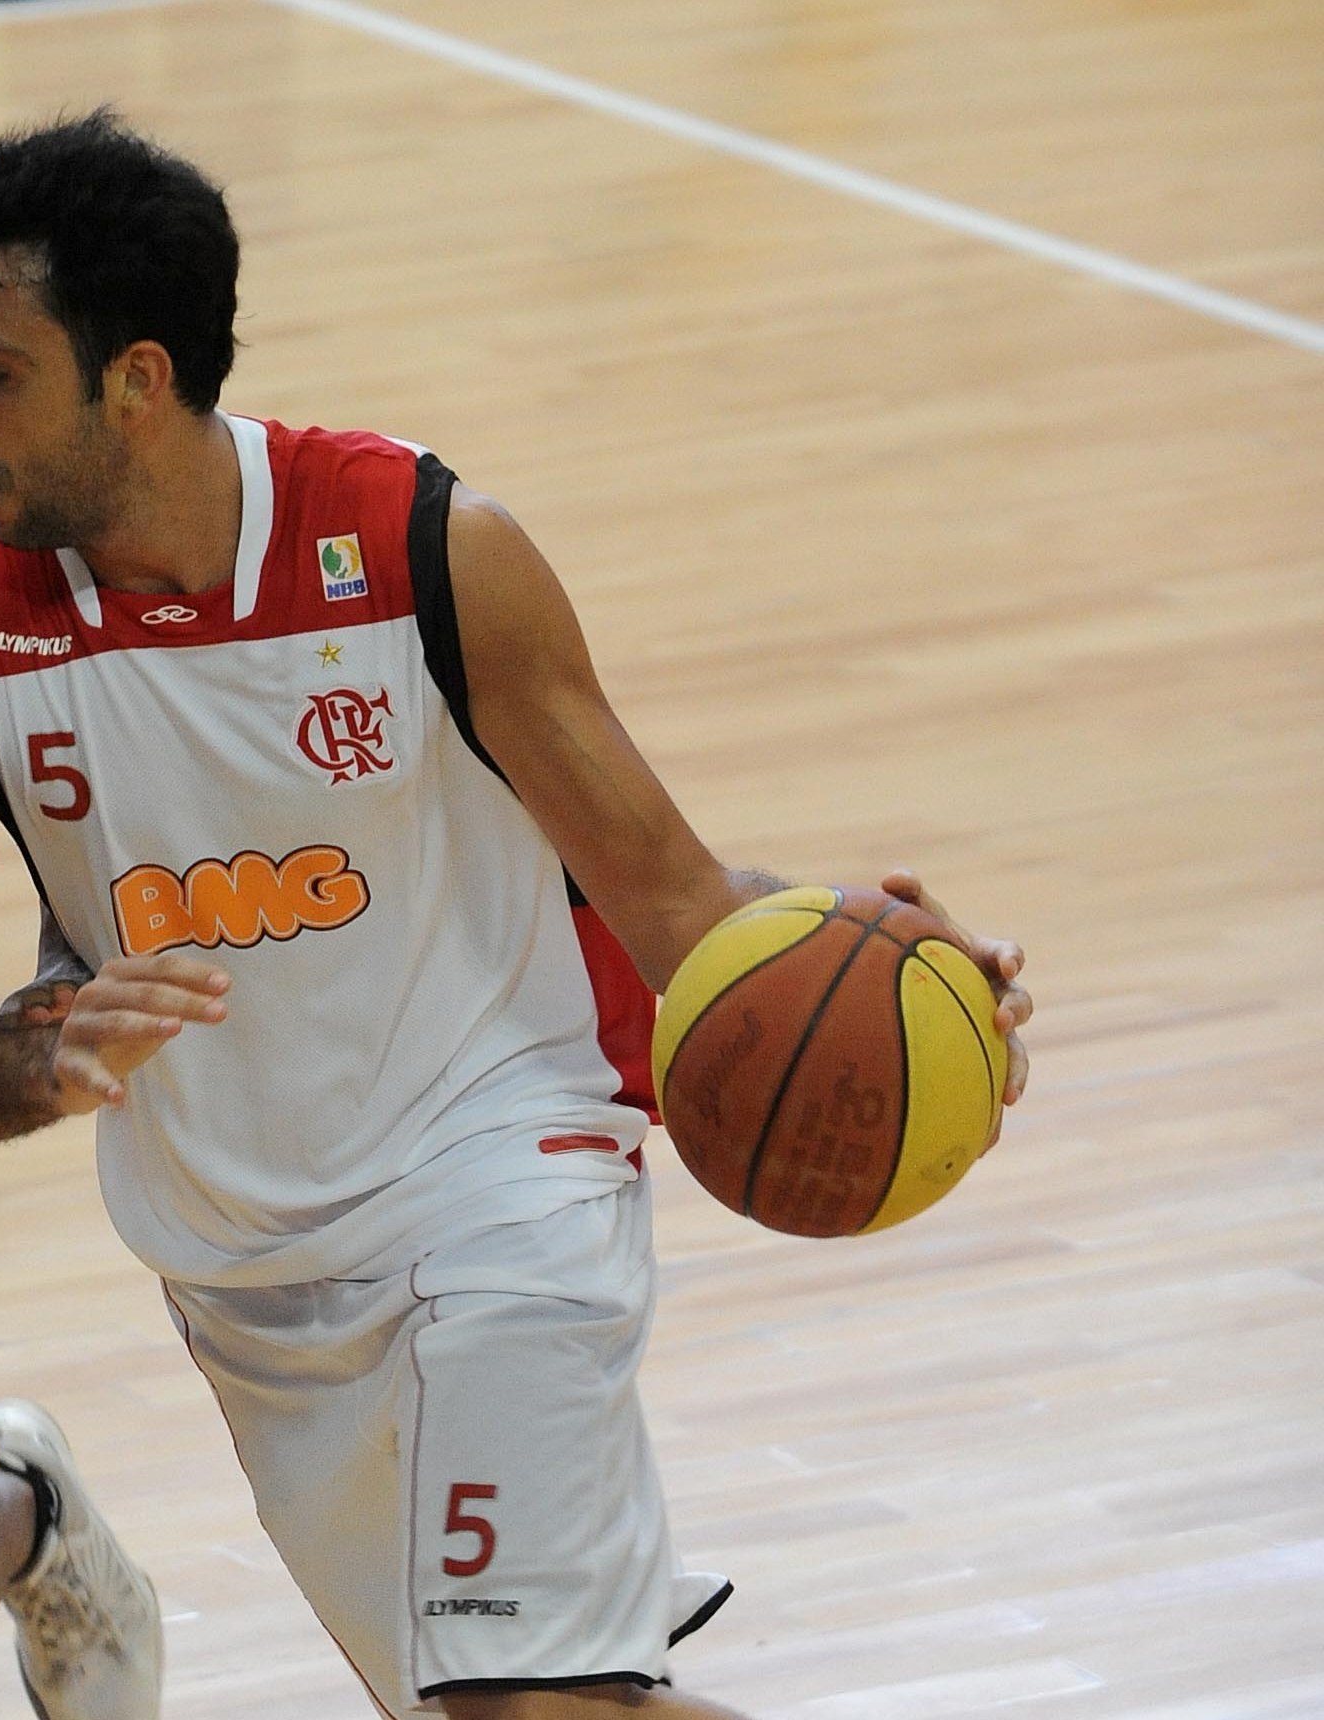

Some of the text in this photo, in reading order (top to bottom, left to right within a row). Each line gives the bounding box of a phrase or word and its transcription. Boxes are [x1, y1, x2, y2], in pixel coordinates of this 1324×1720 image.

[326, 579, 366, 600] NBB
[27, 730, 92, 822] 5
[110, 844, 371, 957] BMG
[442, 1483, 497, 1576] 5
